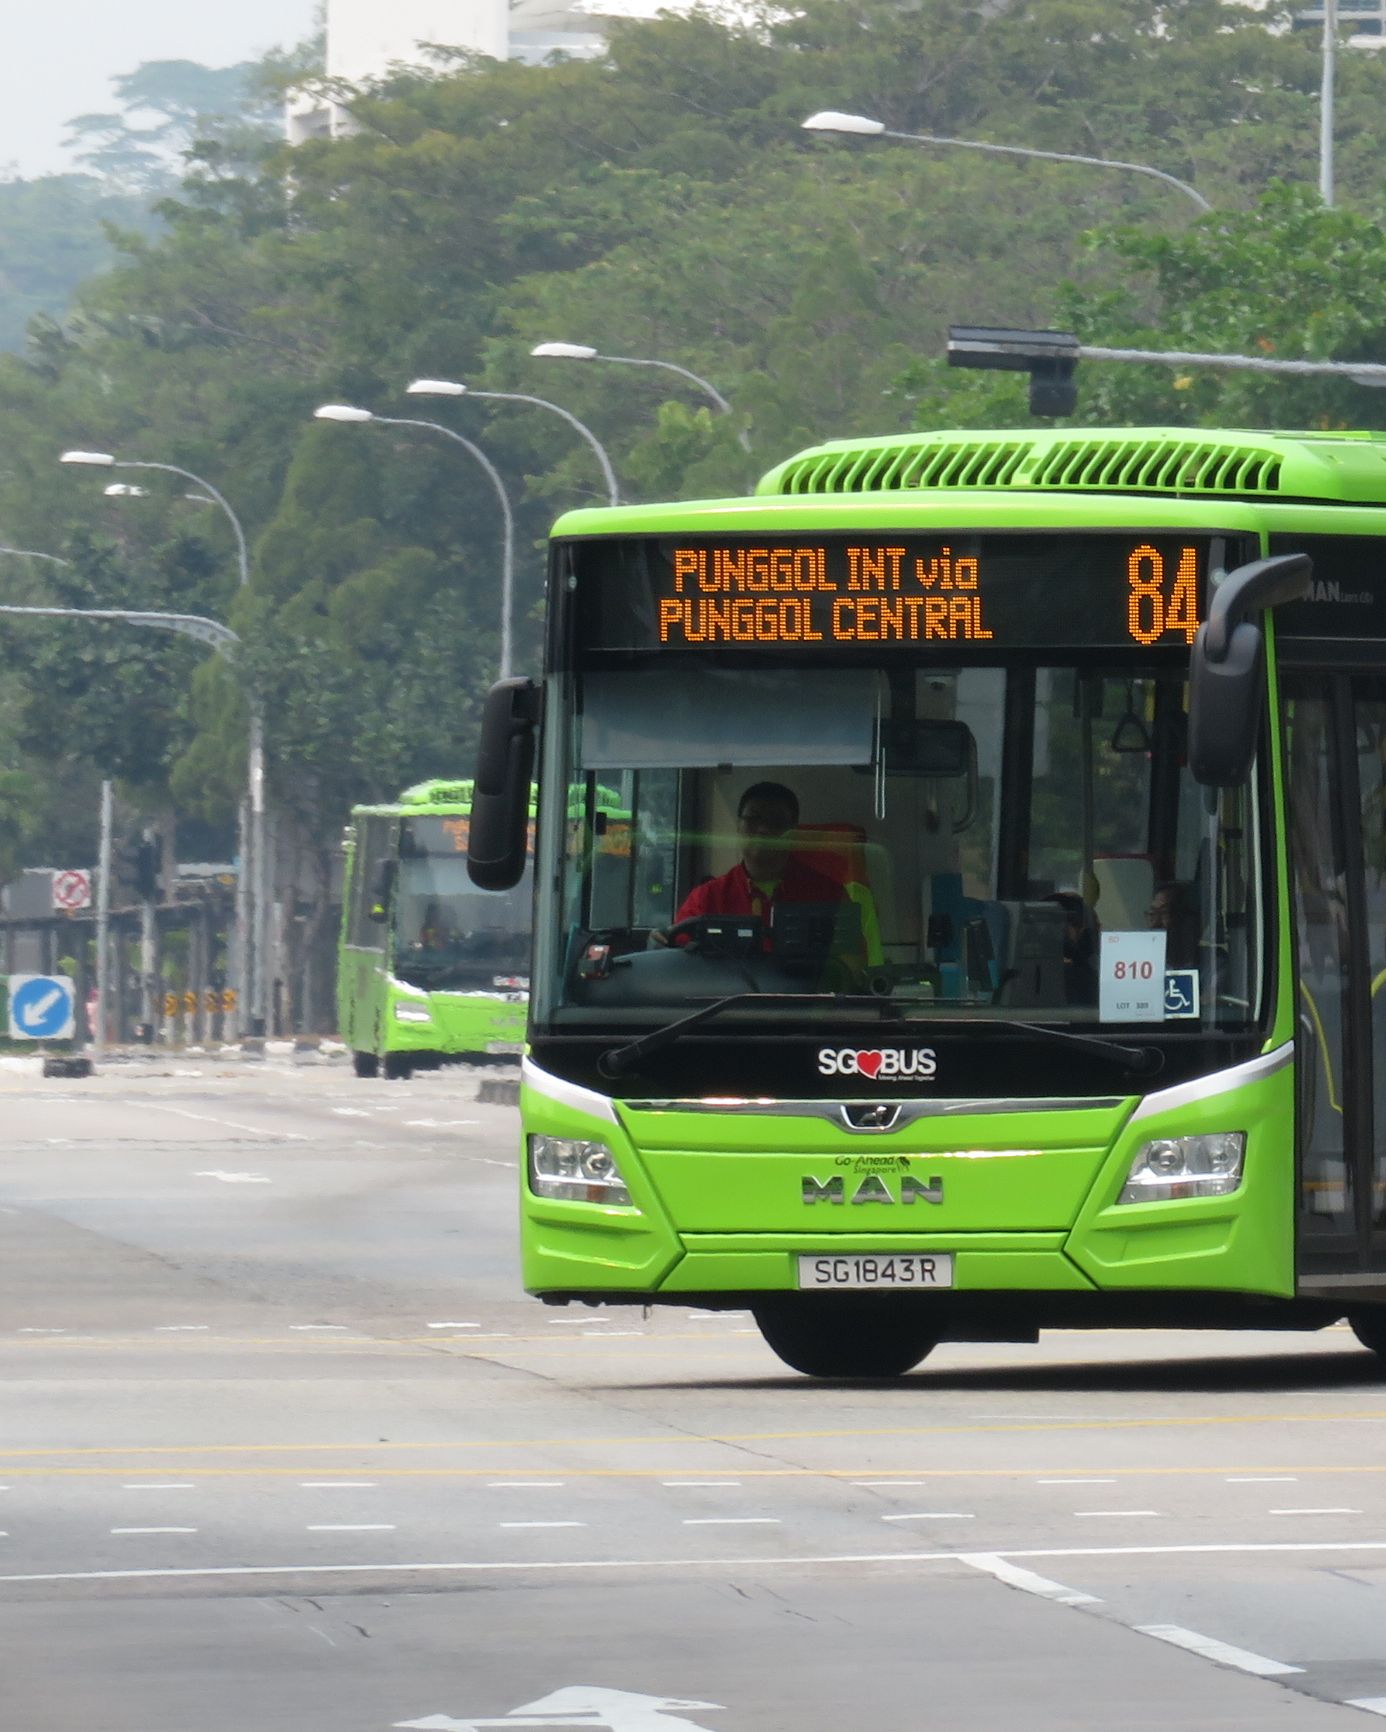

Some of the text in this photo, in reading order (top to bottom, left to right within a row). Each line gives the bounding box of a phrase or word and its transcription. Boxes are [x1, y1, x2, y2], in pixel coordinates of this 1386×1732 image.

[674, 546, 979, 593] PUNGGOL INT via
[1128, 544, 1200, 645] 84
[659, 596, 994, 642] PUNGGOL CENTRAL
[1114, 961, 1153, 980] 810
[802, 1176, 943, 1205] MAN
[815, 1259, 936, 1283] SG1843R
